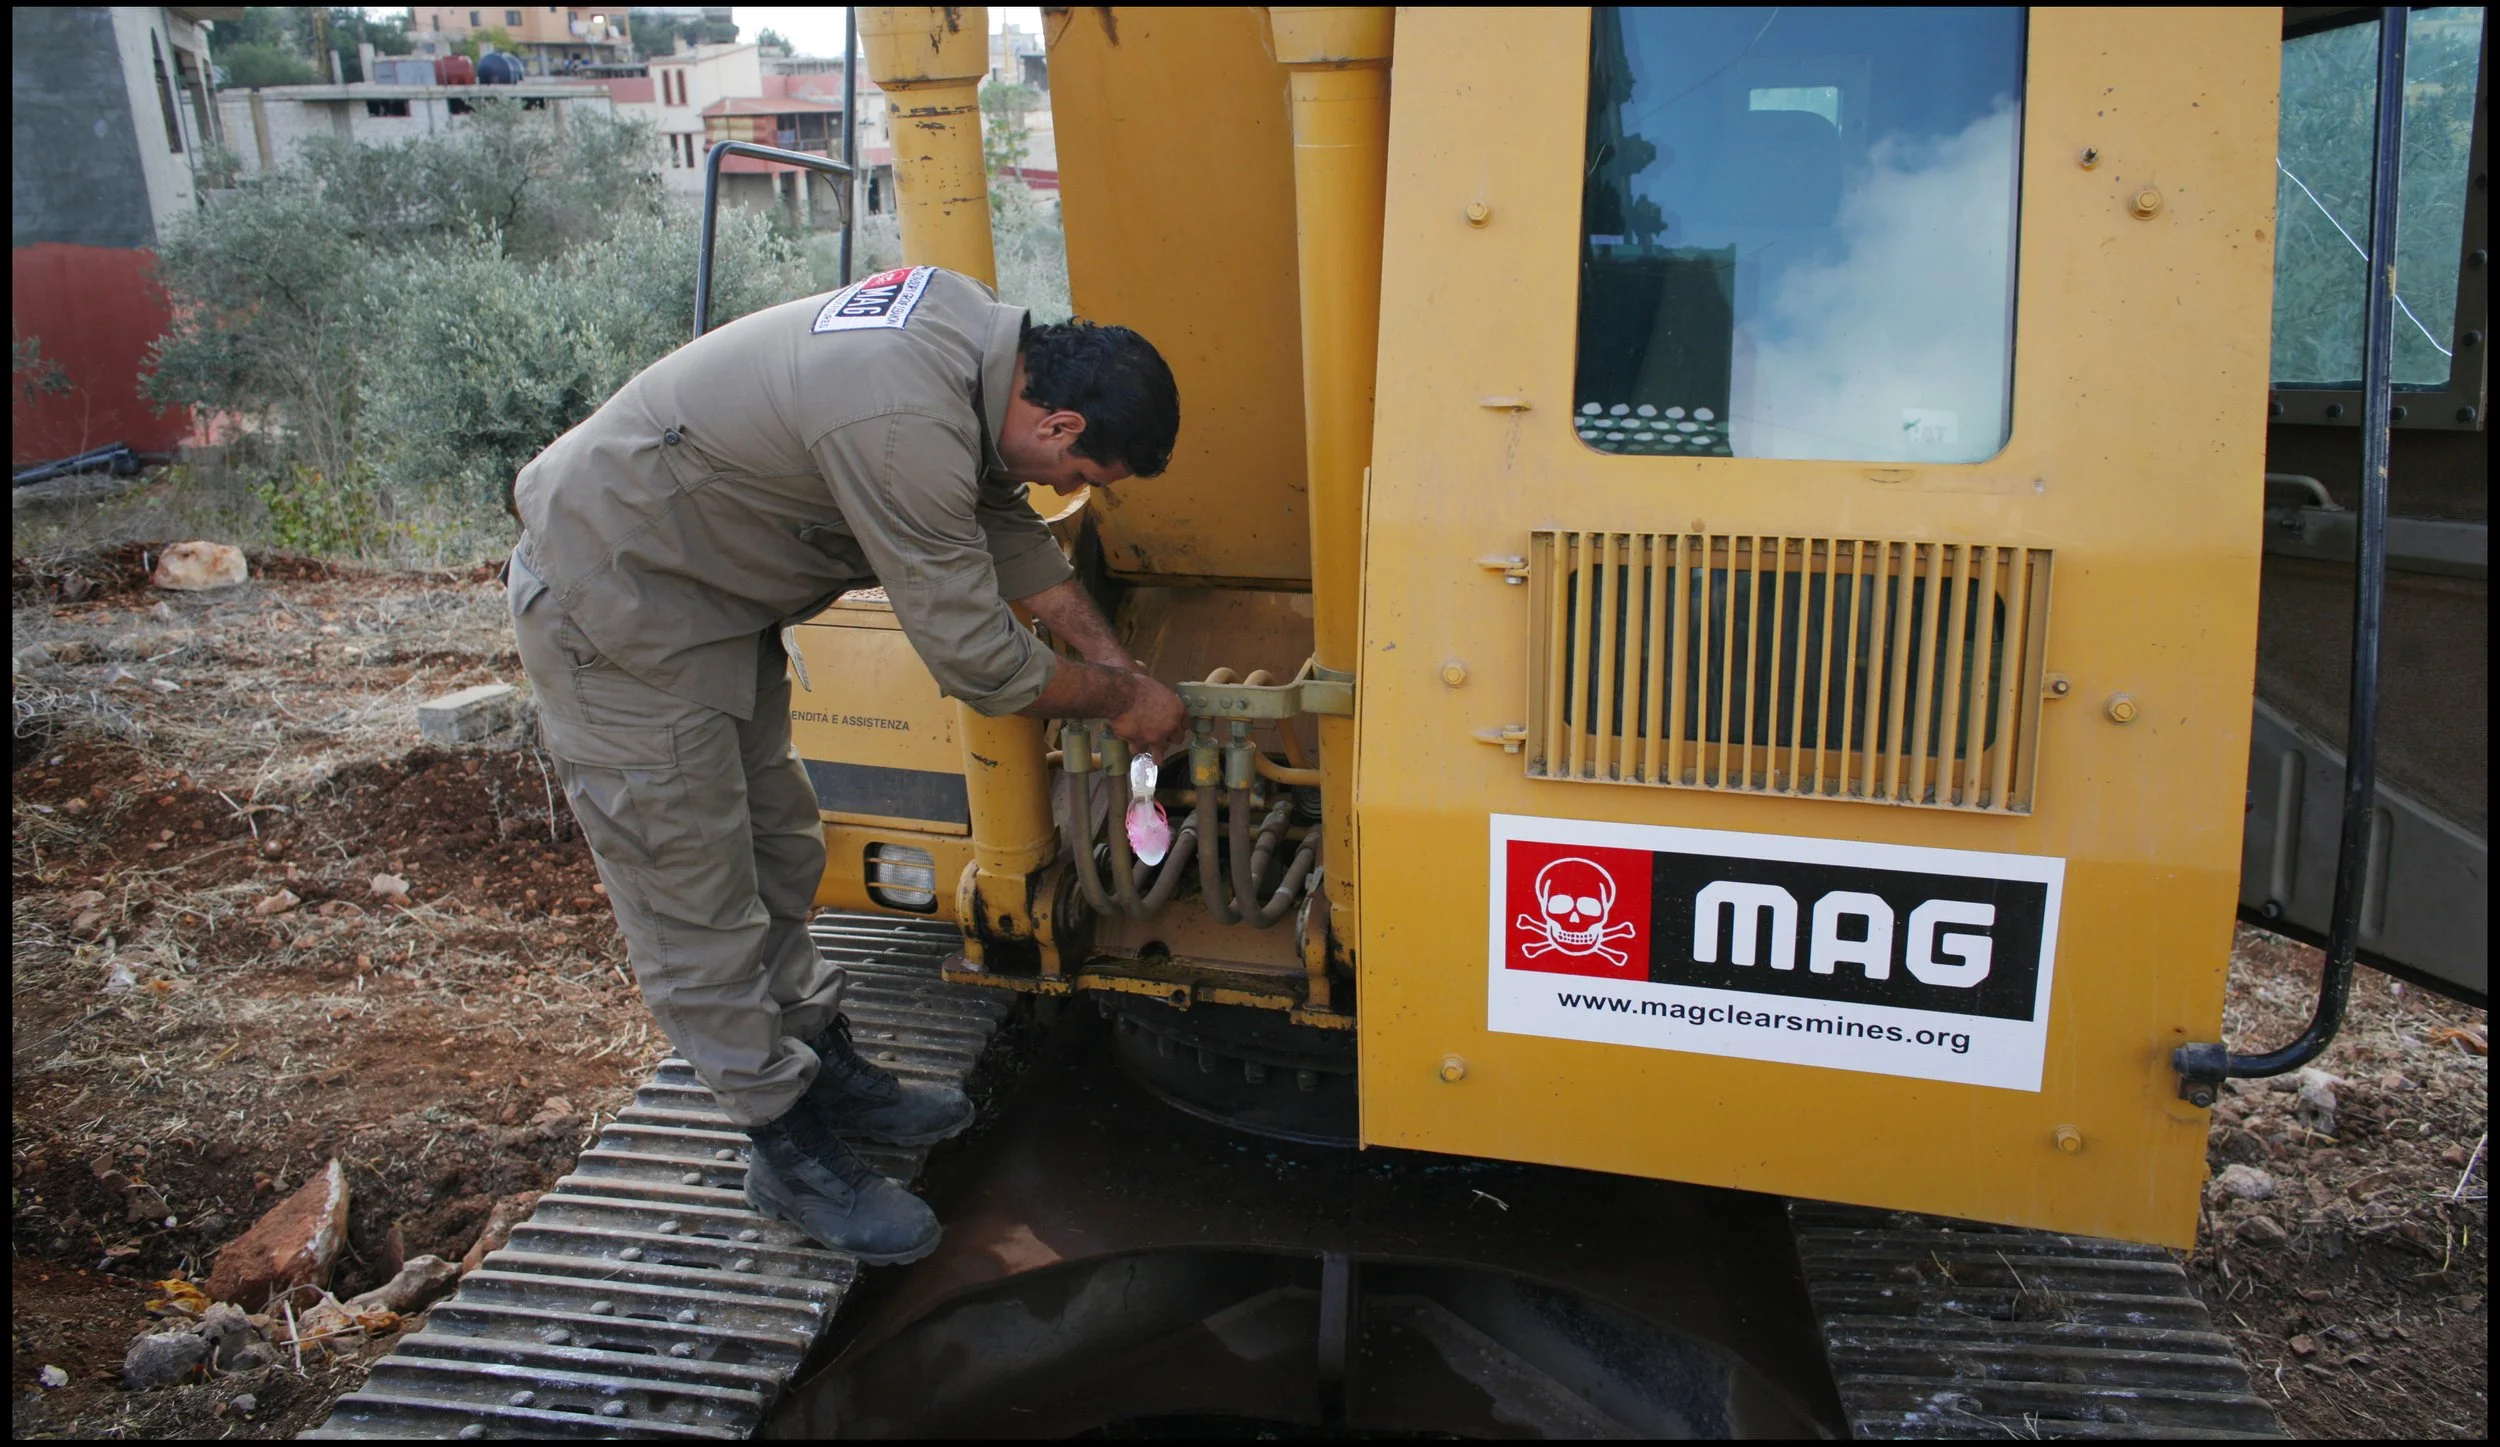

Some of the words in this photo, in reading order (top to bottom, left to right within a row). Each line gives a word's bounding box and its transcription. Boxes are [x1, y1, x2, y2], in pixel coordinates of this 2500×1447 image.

[843, 285, 898, 315] MAG
[791, 711, 828, 723] ENDITA
[832, 714, 838, 724] E
[841, 715, 910, 731] ASSISTENZA
[1693, 880, 1996, 988] MAG
[1557, 991, 1971, 1054] www.magclearsmines.org
